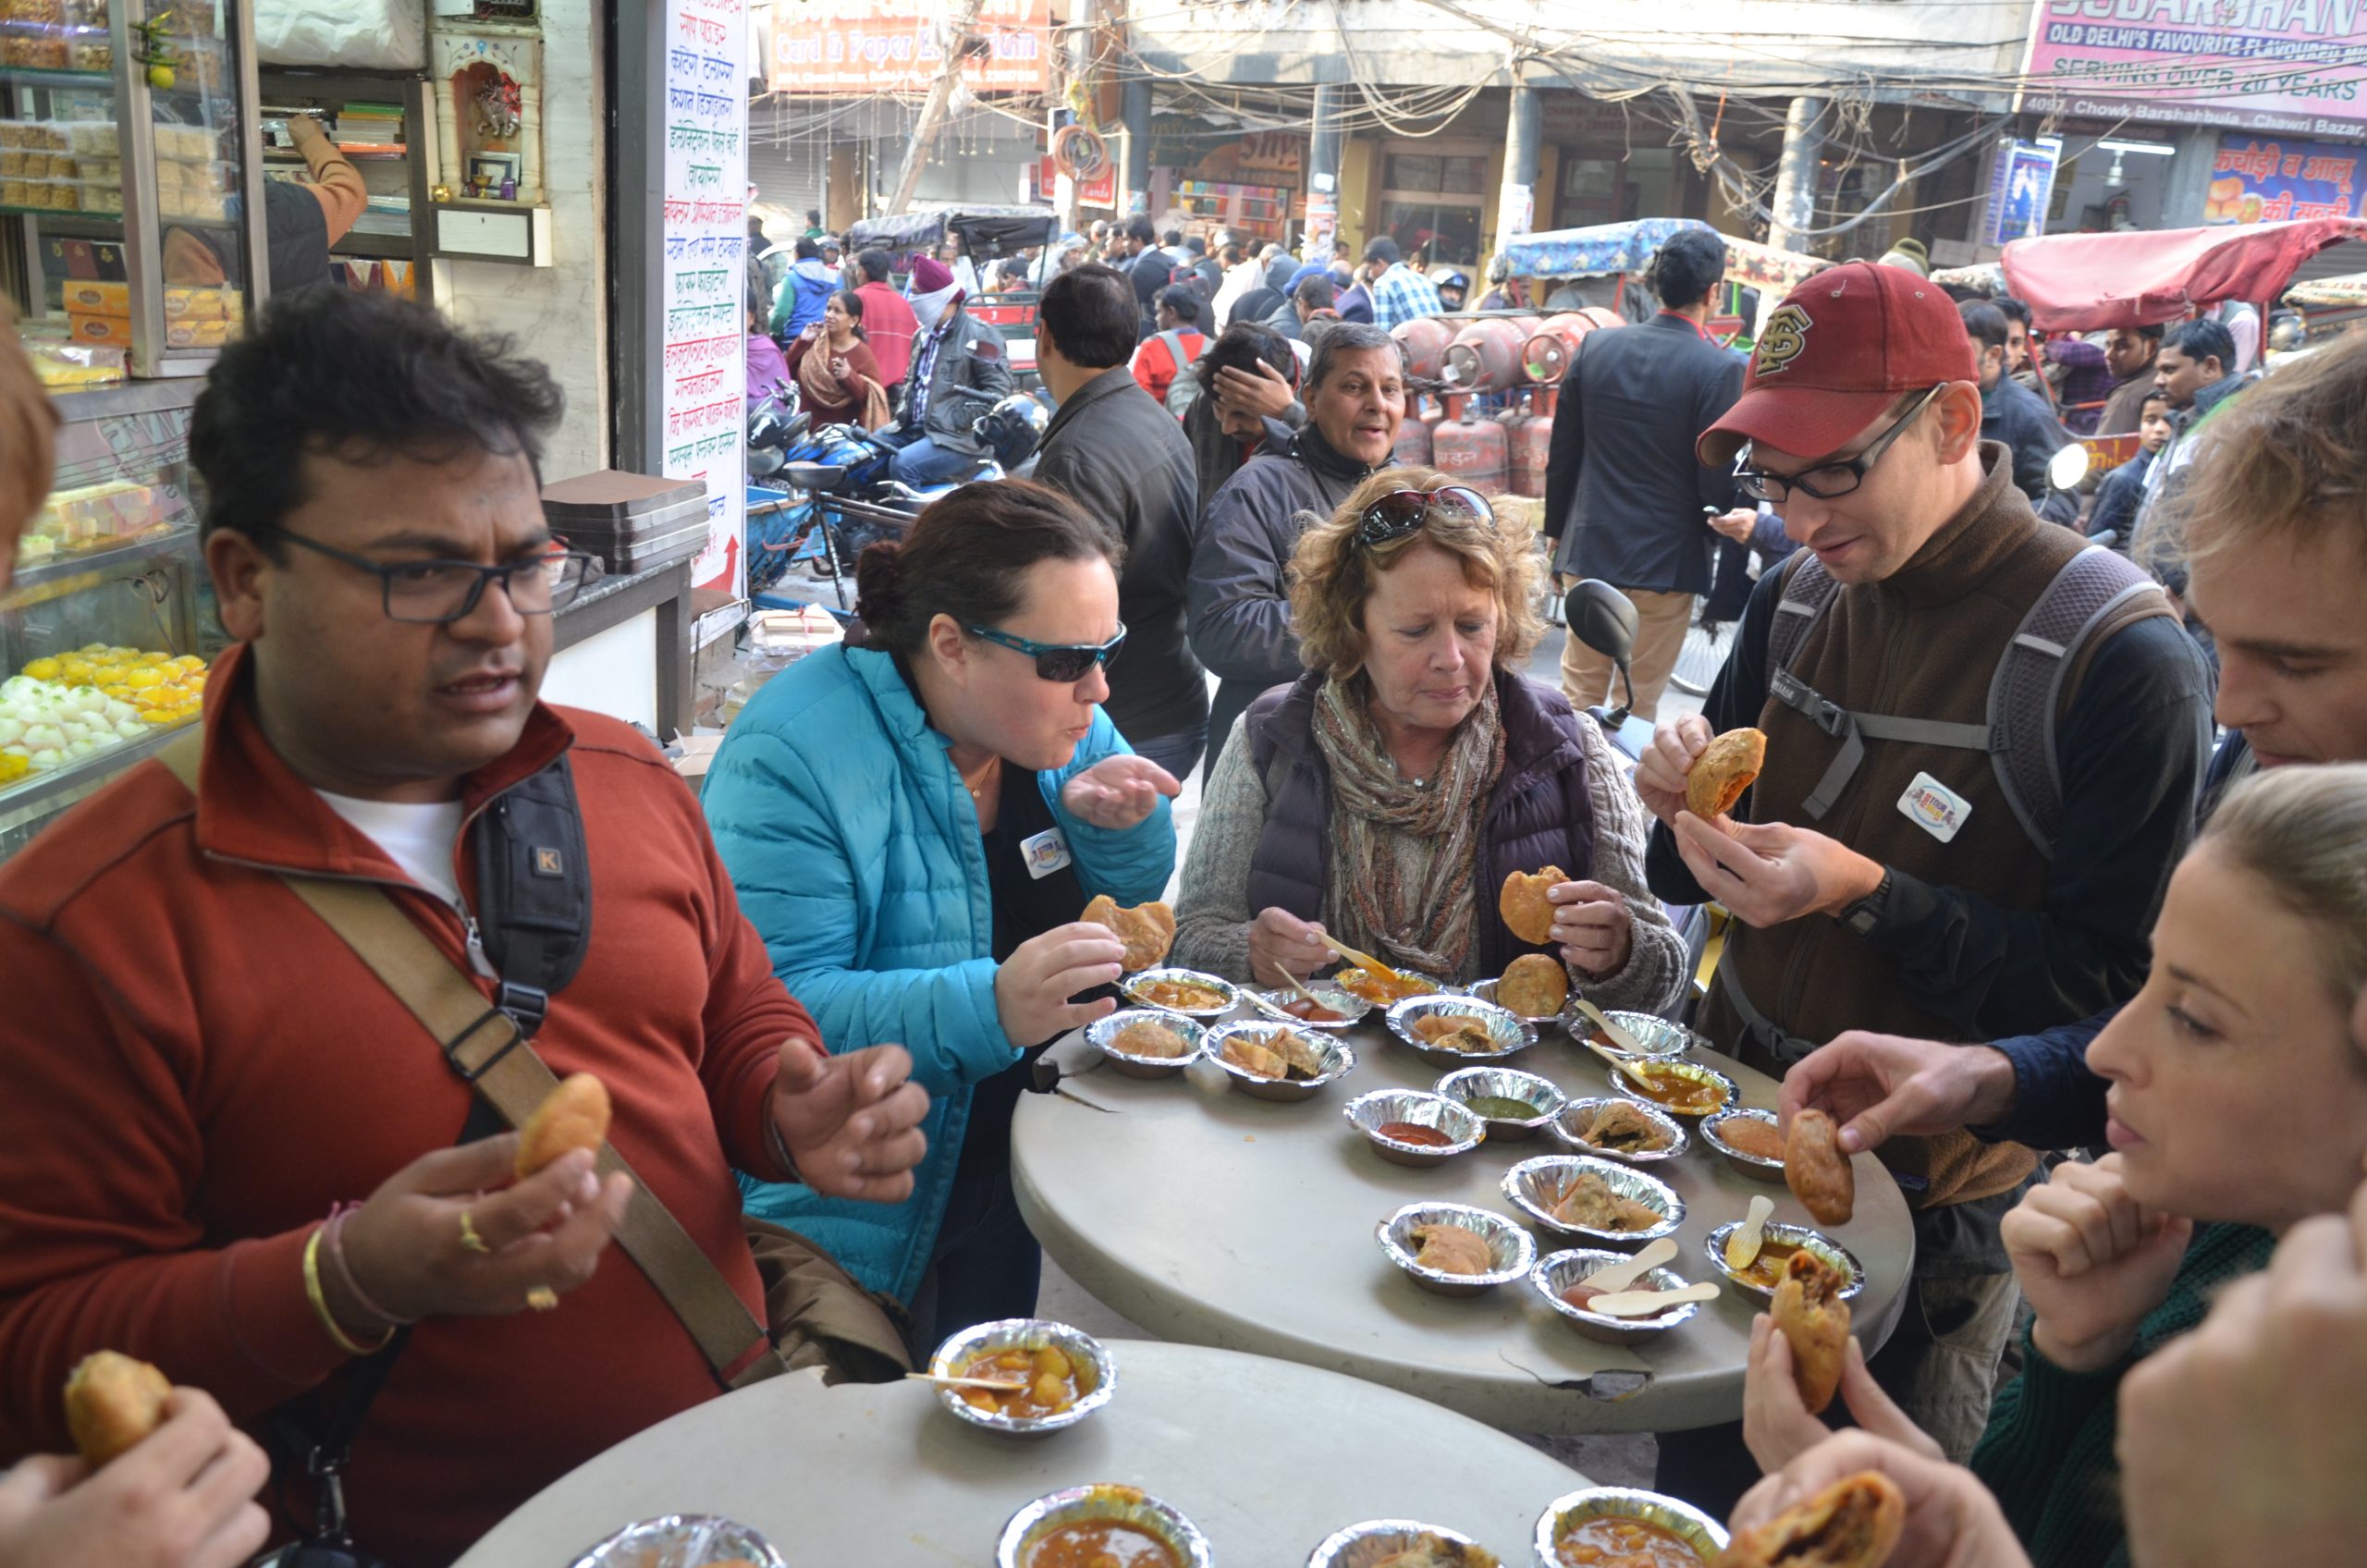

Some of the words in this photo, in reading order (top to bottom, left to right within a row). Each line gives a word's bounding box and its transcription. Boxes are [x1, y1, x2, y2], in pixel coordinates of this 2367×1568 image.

[776, 31, 821, 65] Card
[849, 30, 914, 68] Paper
[2050, 24, 2082, 43] OLD
[2085, 26, 2150, 50] DELHI'S
[2151, 31, 2243, 56] FAVOURITE
[2053, 57, 2162, 84] SERVING
[2277, 74, 2359, 101] YEARS
[2074, 100, 2131, 117] Chowk
[2252, 113, 2311, 132] Chawri
[2314, 119, 2366, 138] Bazar,
[2302, 155, 2358, 194] आलू
[540, 851, 558, 870] K
